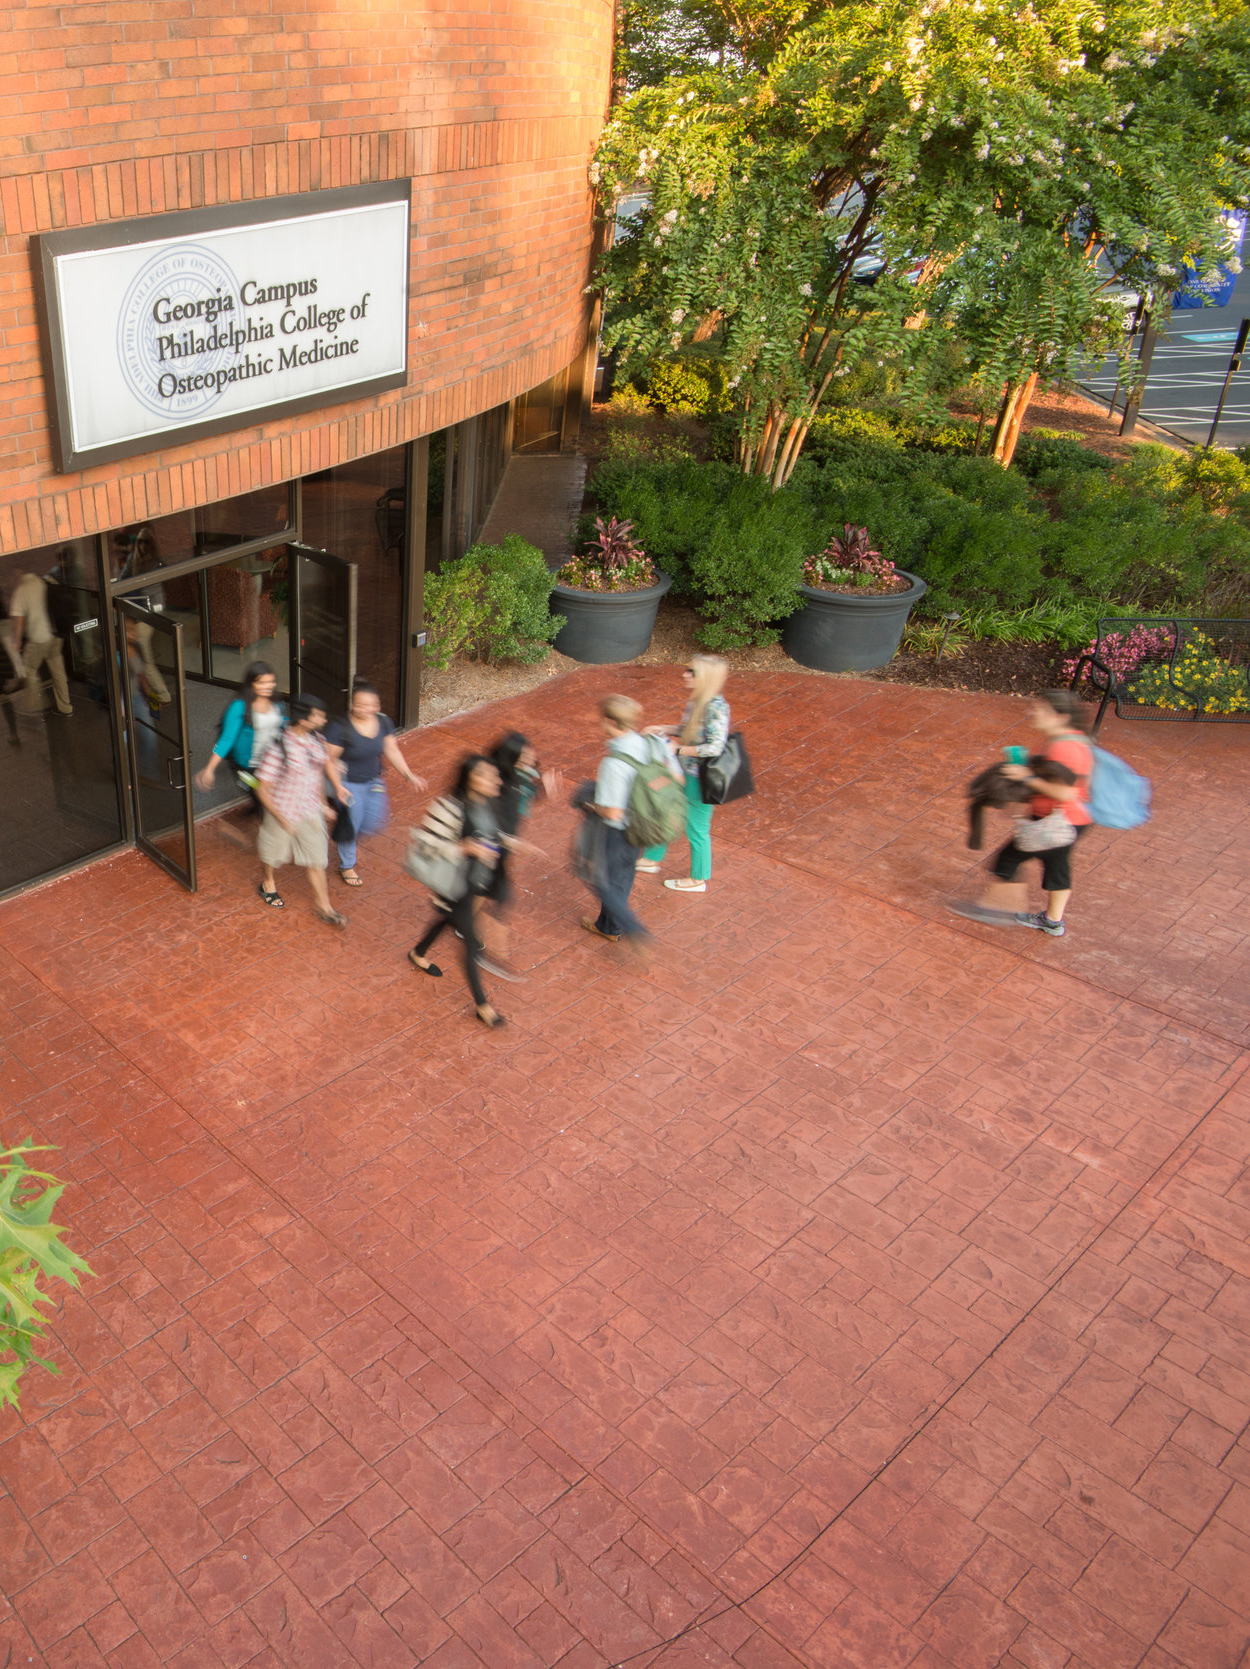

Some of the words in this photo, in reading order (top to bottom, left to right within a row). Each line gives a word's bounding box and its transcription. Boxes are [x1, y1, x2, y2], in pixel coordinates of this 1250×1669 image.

[131, 261, 172, 314] COLLEGE
[172, 257, 187, 269] OF
[152, 287, 235, 324] Georgia
[239, 278, 318, 308] Campus
[156, 317, 275, 362] Philadelphia
[279, 304, 346, 335] College
[350, 293, 371, 320] of
[157, 353, 274, 399] Osteopathic
[278, 335, 359, 372] Medicine
[176, 394, 199, 407] 1899
